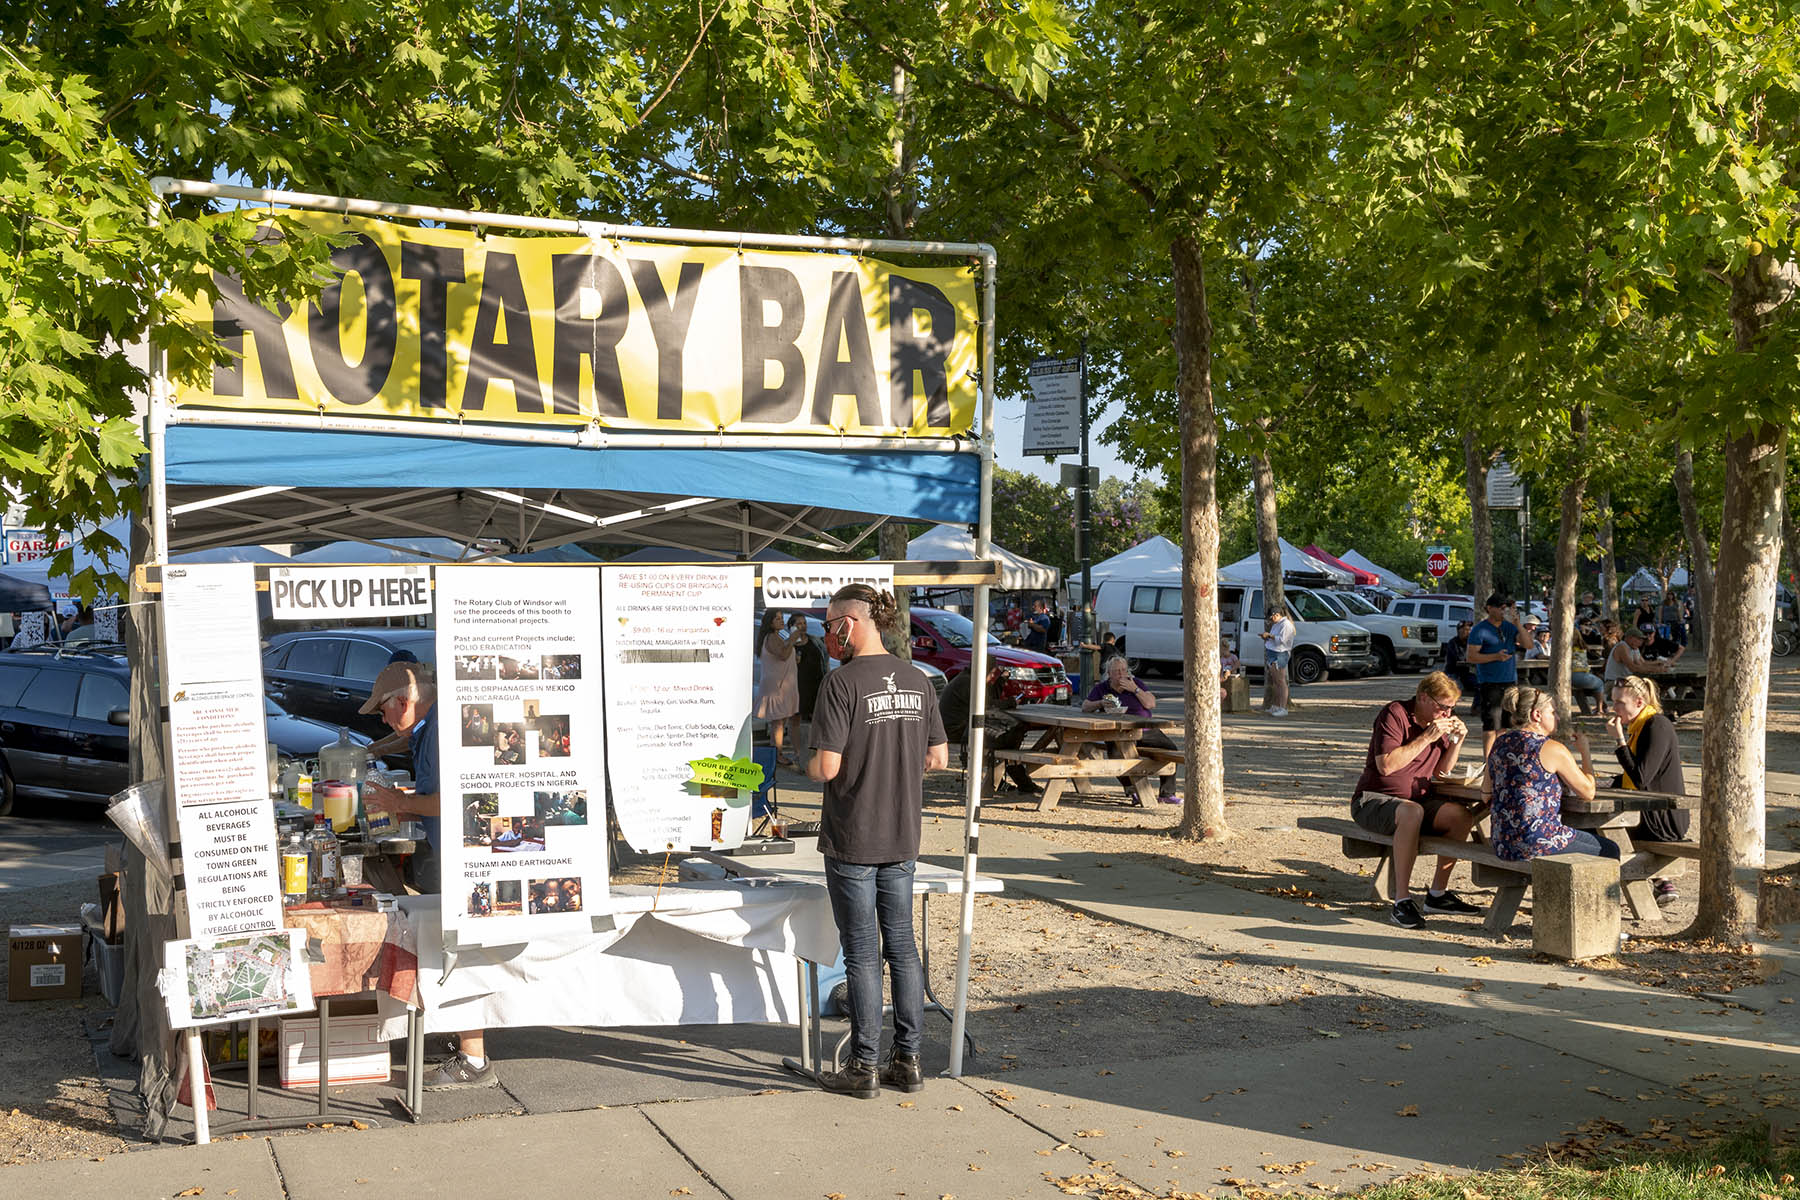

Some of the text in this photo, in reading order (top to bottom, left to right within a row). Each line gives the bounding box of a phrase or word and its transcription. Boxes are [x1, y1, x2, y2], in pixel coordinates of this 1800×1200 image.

[740, 264, 956, 429] BAR
[1429, 561, 1448, 570] STOP
[766, 576, 834, 599] ORDER
[274, 578, 427, 608] PICK UP HERE
[740, 768, 757, 776] BUY!
[214, 807, 258, 818] ALCOHOLIC
[206, 821, 250, 831] BEVERAGES
[214, 835, 235, 843] MUST
[194, 848, 238, 858] CONSUMED
[206, 858, 257, 870] TOWN GREEN
[519, 858, 572, 866] EARTHQUAKE
[198, 871, 251, 884] REGULATIONS
[222, 885, 245, 894] BEING
[197, 895, 273, 909] STRICTLY ENFORCED
[220, 908, 264, 919] ALCOHOLIC
[240, 921, 276, 931] CONTROL
